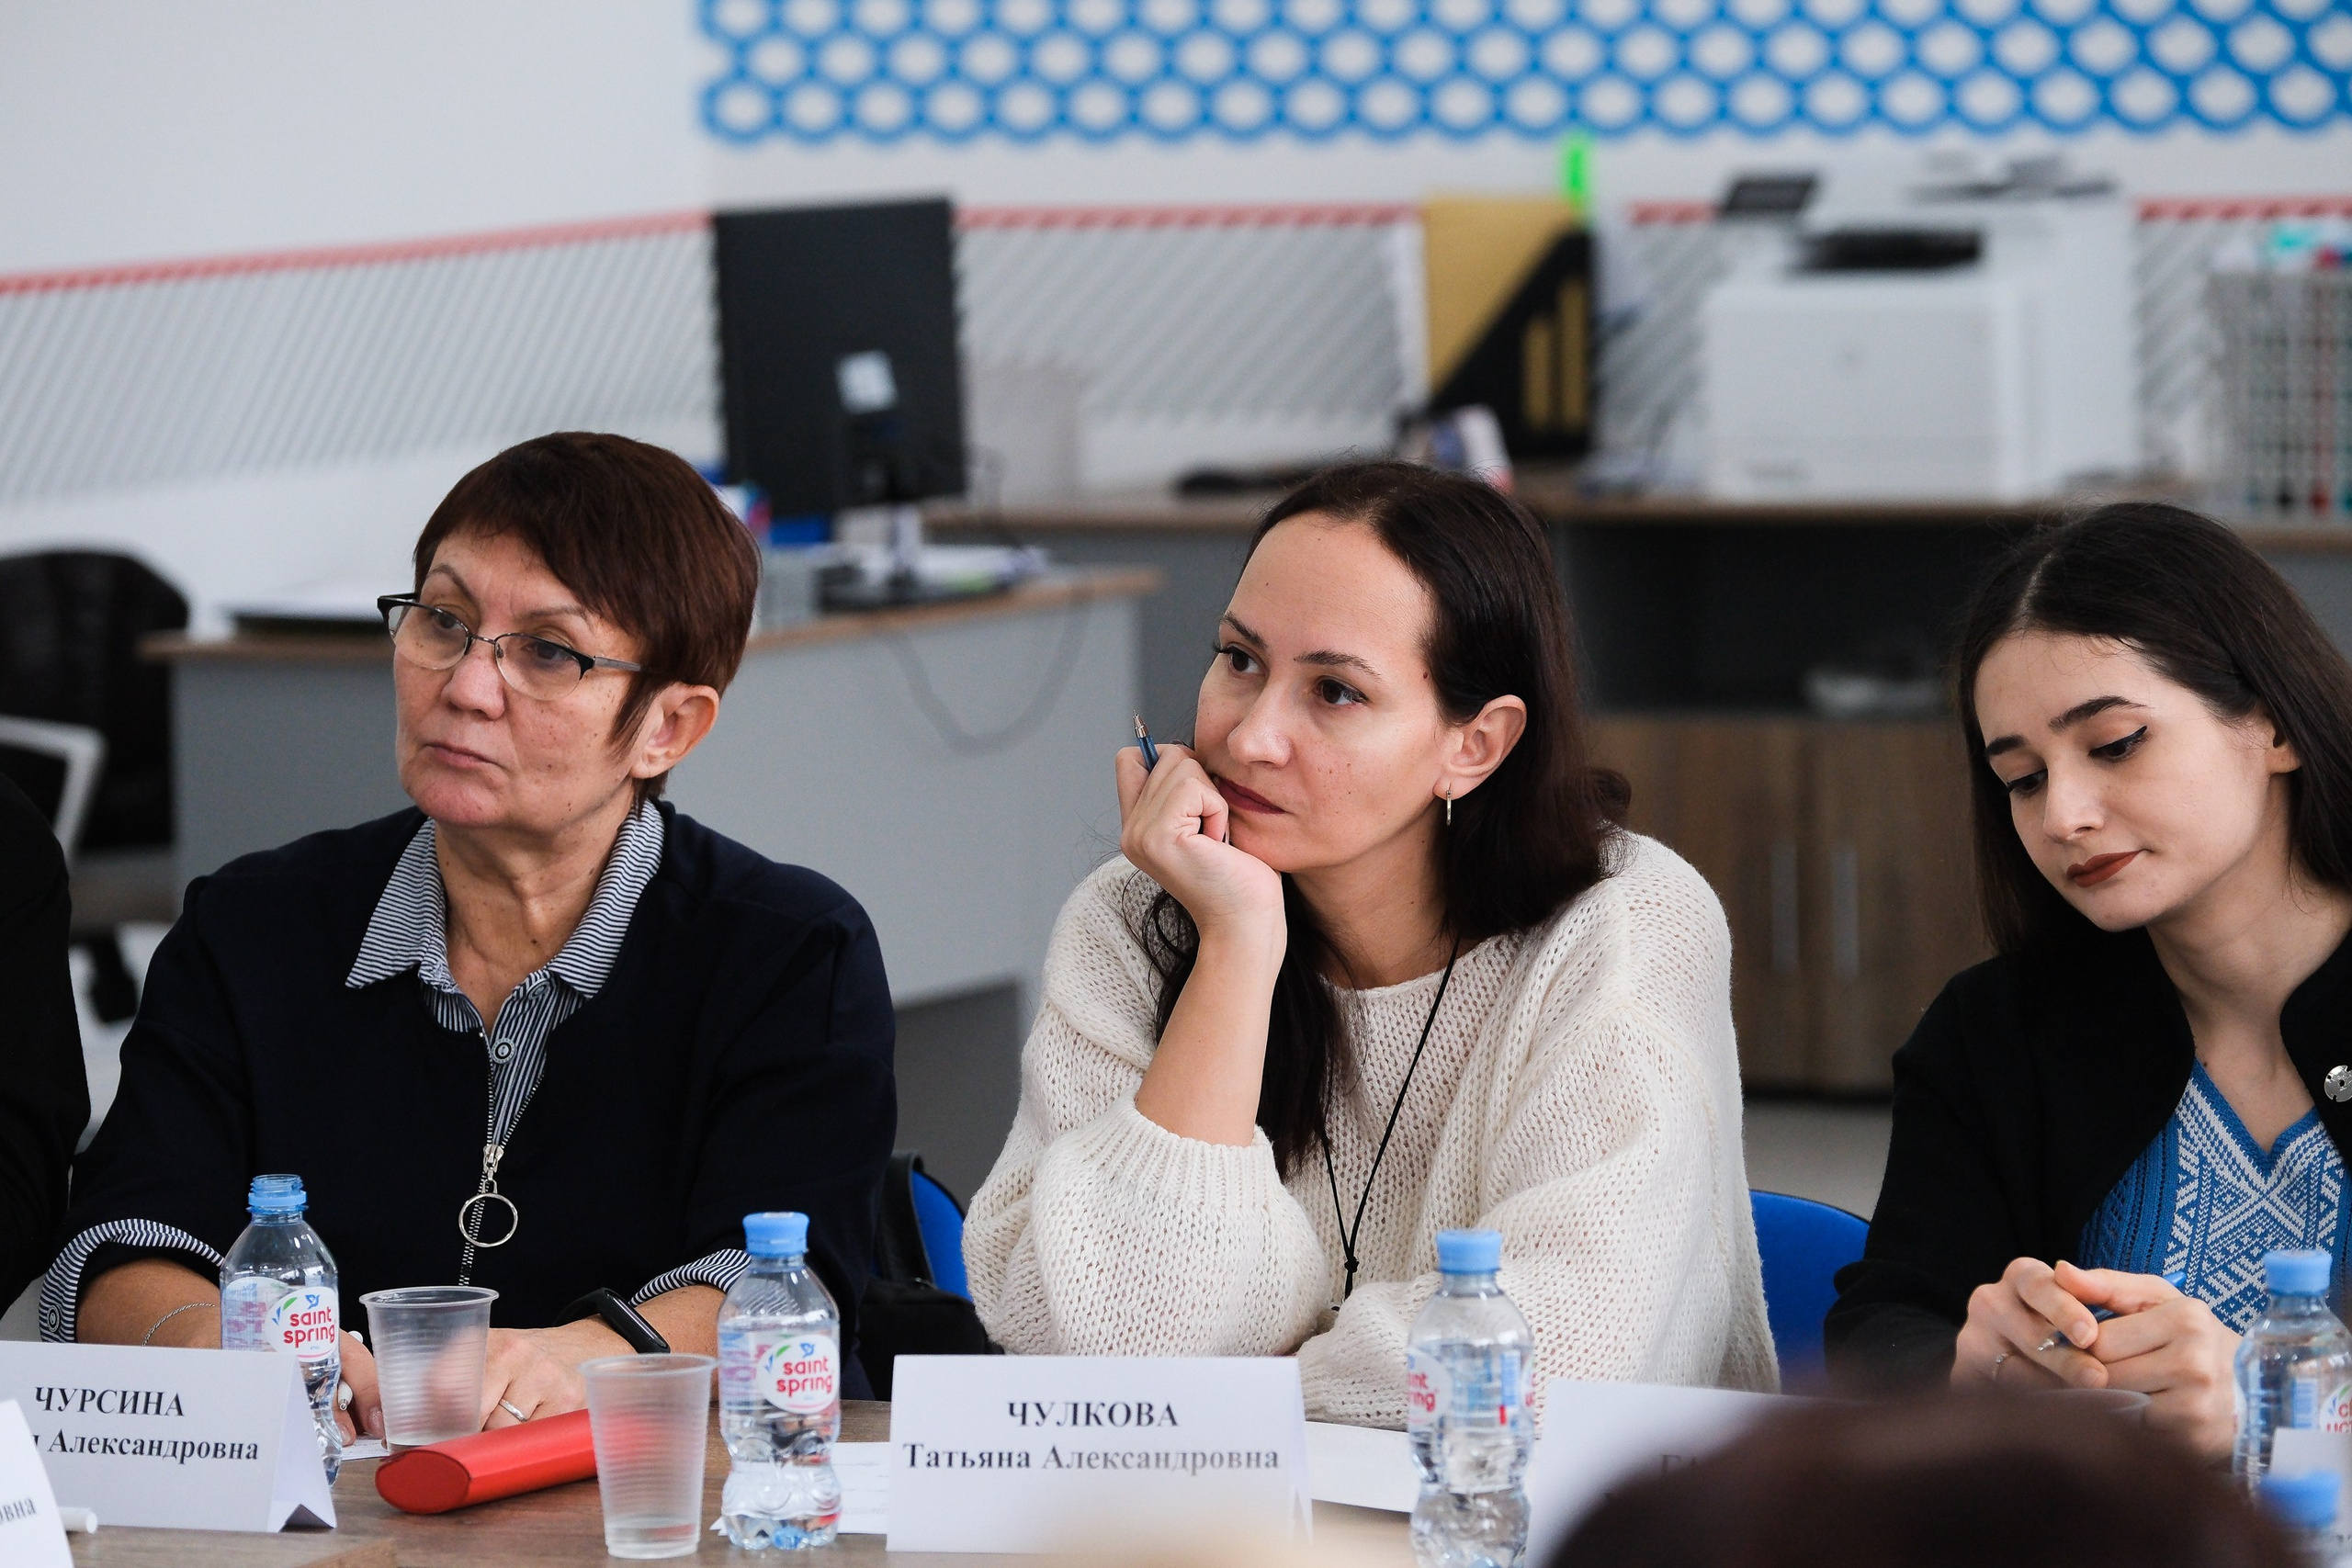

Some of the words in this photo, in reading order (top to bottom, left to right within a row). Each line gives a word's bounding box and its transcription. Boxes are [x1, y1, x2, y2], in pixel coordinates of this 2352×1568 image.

[289, 1306, 332, 1327] saint
[283, 1325, 335, 1348] spring
[783, 1357, 829, 1376] saint
[776, 1375, 832, 1397] spring
[35, 1386, 185, 1416] ЧУРСИНА
[1007, 1402, 1180, 1427] ЧУЛКОВА
[47, 1428, 259, 1465] Александровна
[903, 1443, 1031, 1470] Татьяна
[1041, 1445, 1279, 1476] Александровна
